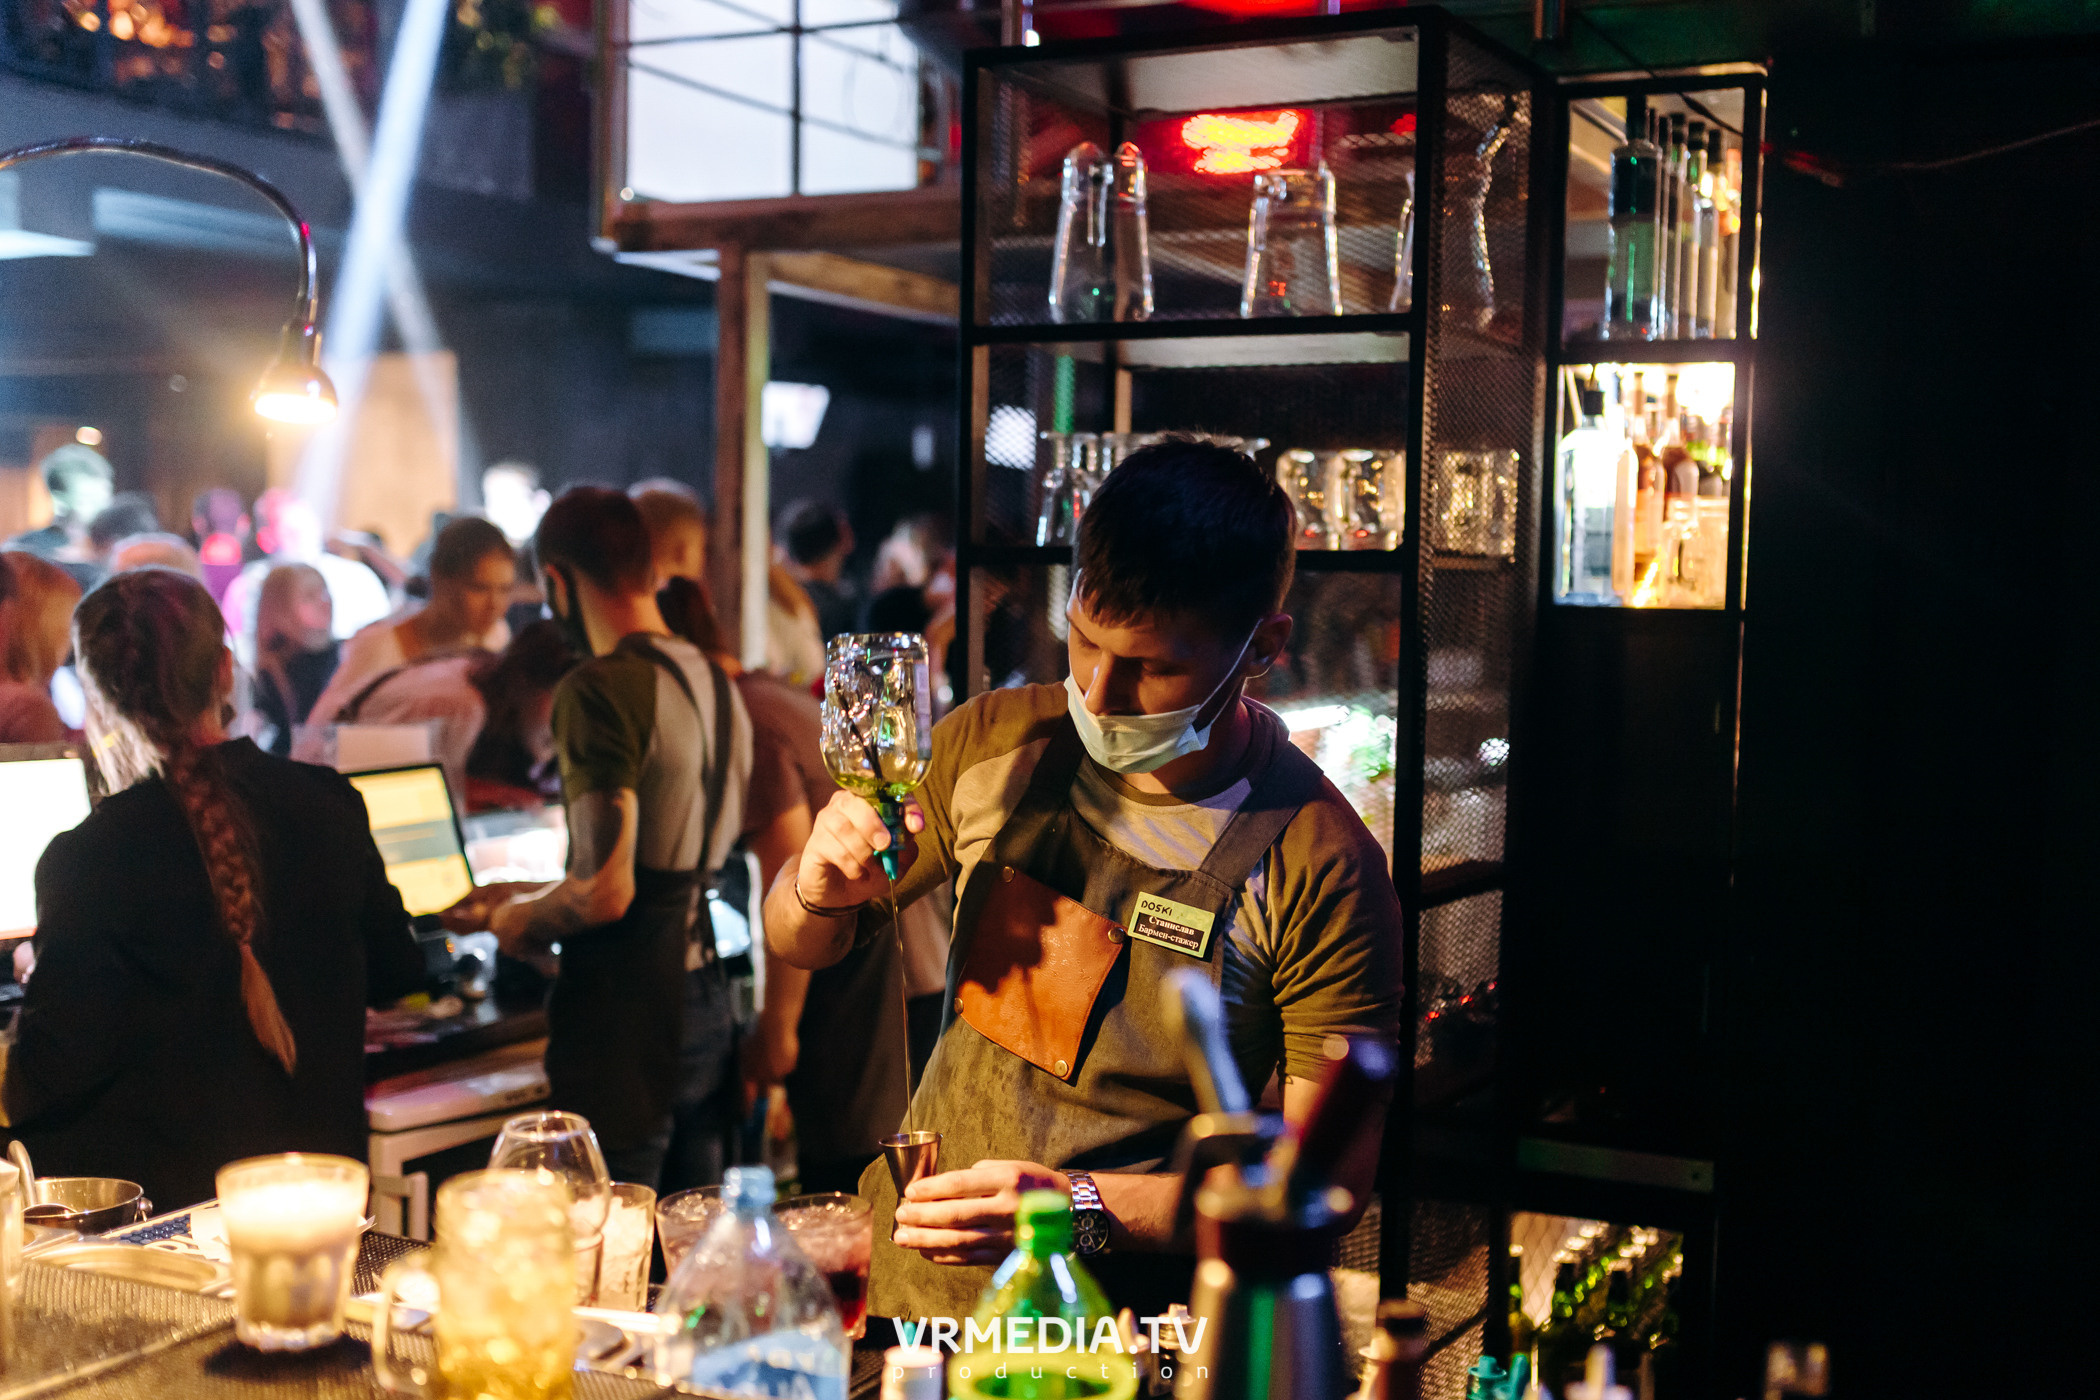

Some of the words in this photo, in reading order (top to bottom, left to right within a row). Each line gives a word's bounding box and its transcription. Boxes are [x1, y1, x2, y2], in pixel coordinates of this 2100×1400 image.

[1141, 900, 1172, 916] DOSKI
[1149, 916, 1195, 936] Станислав
[1138, 924, 1199, 949] Бармен-стажер
